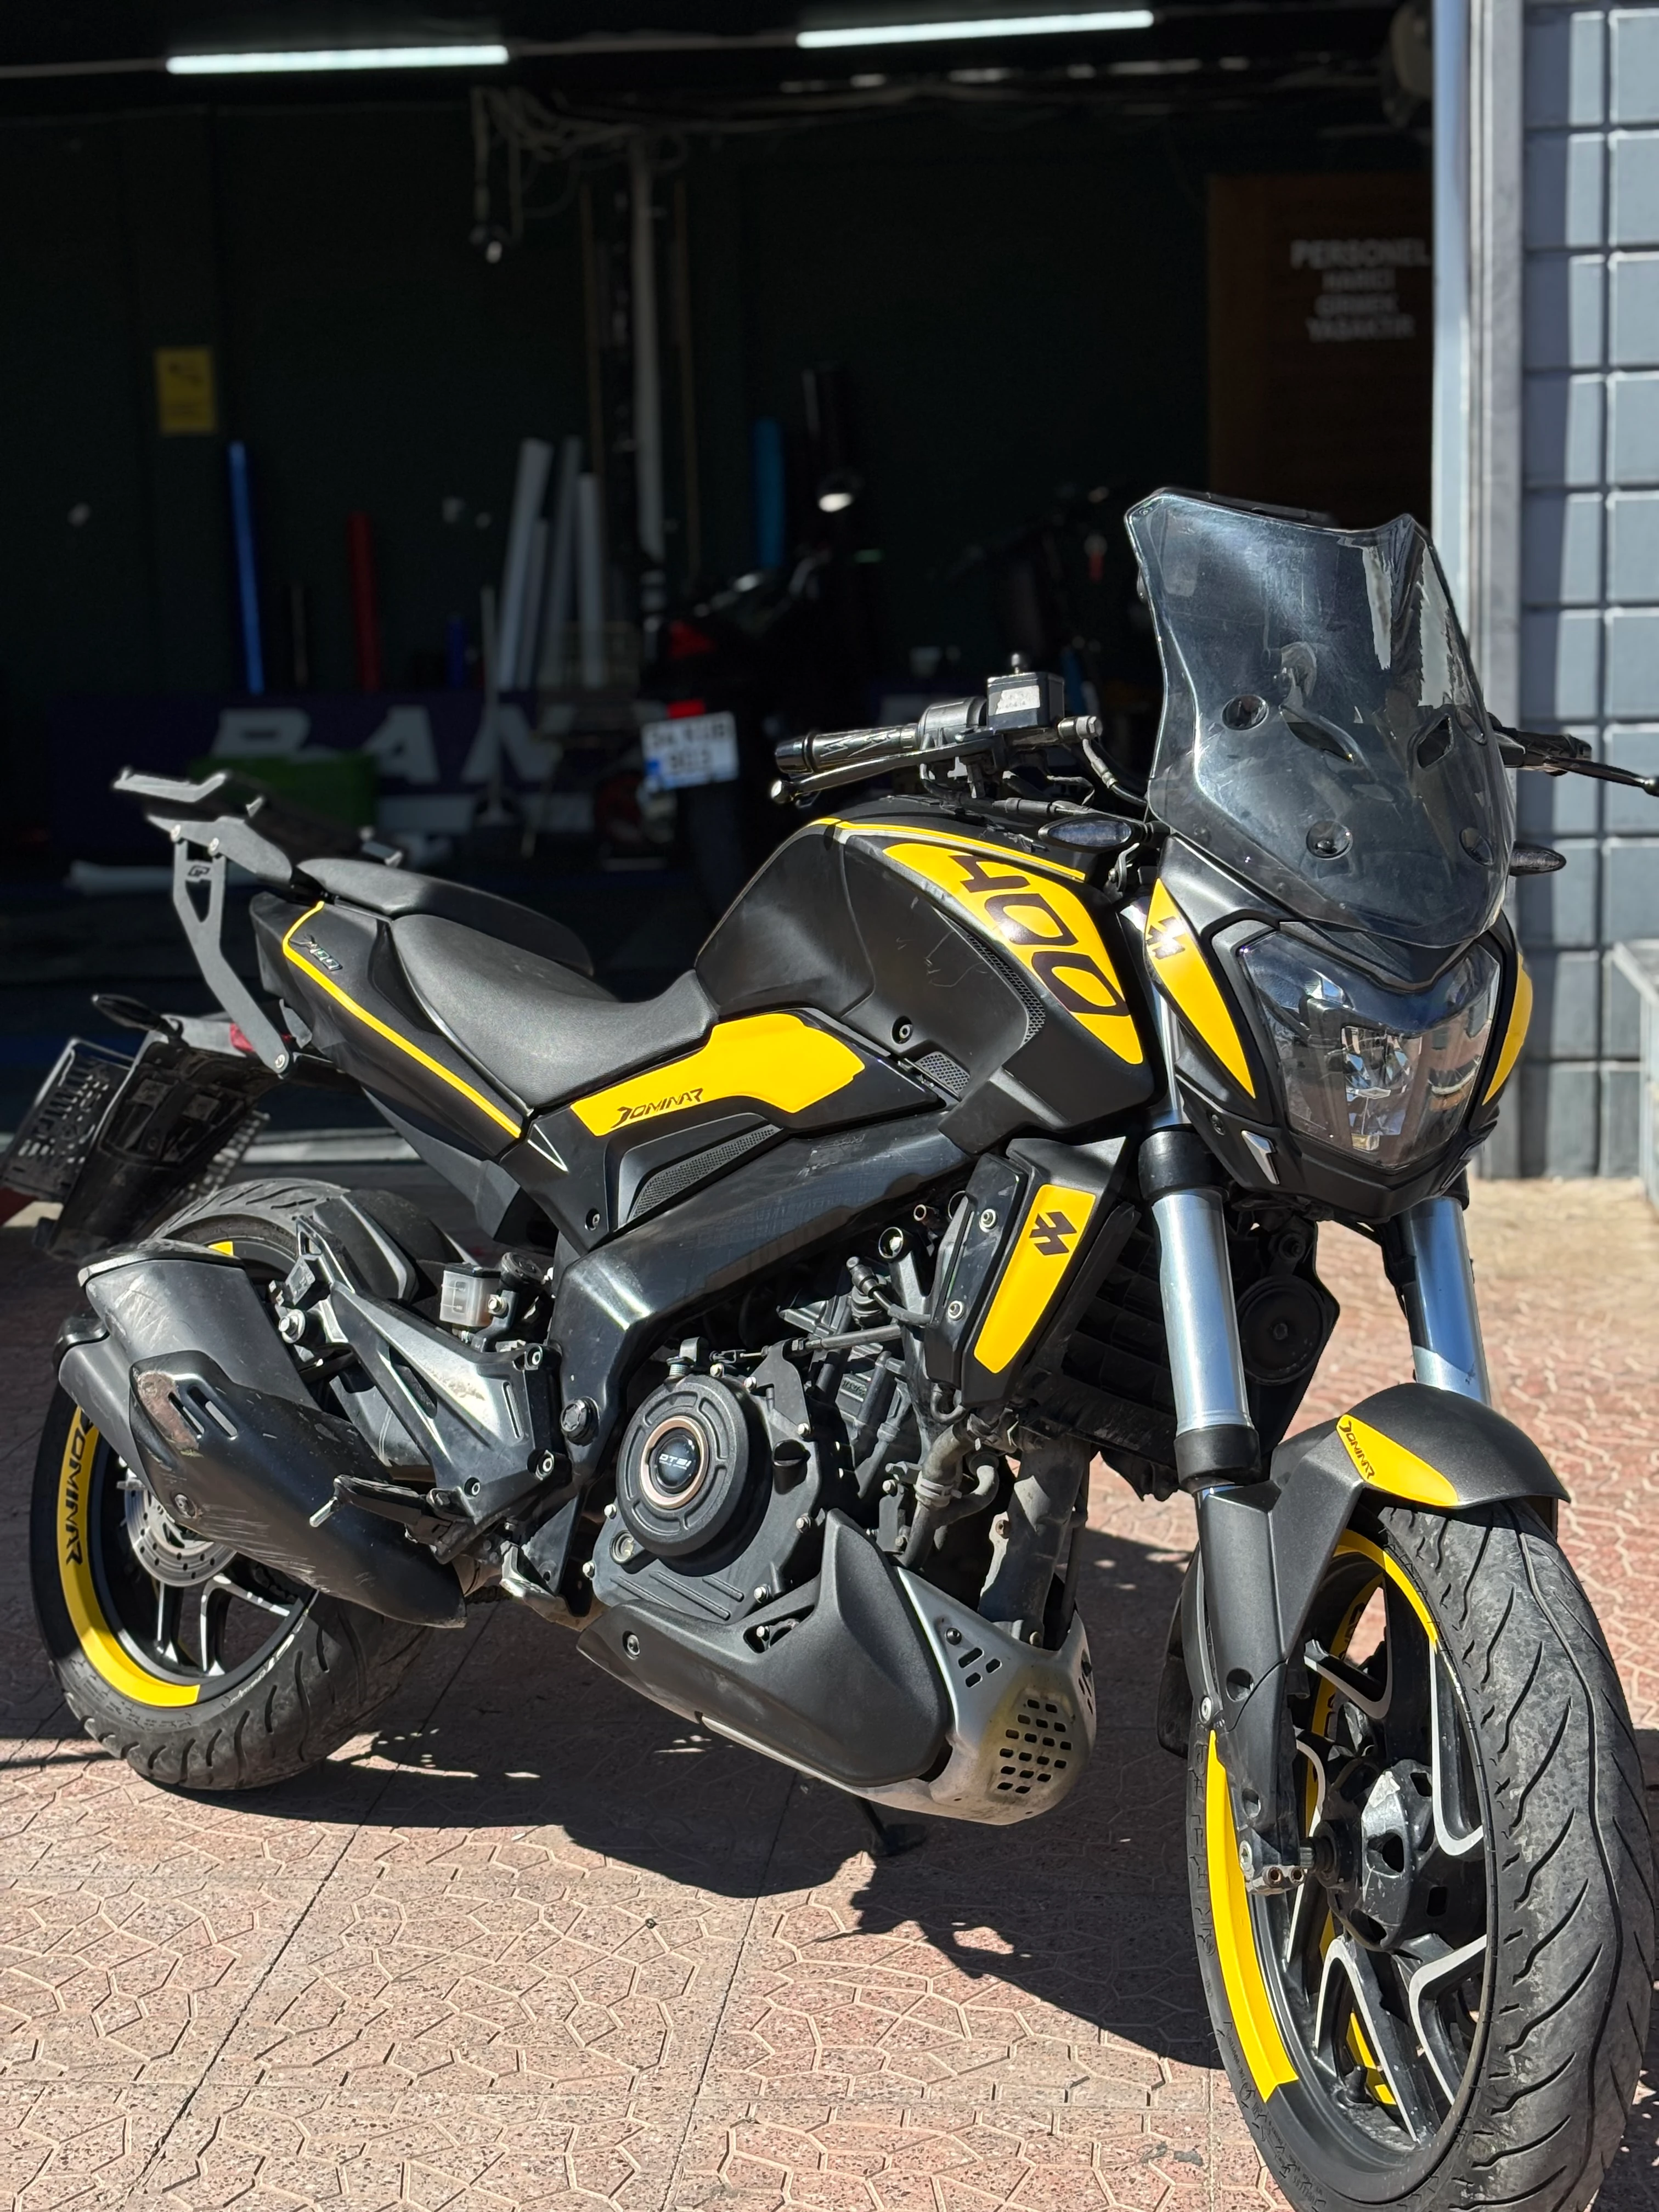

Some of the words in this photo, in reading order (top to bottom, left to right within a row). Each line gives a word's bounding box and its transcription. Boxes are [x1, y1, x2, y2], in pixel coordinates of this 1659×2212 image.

[1290, 239, 1431, 269] PERSONEL
[948, 855, 1130, 1016] 400
[610, 1087, 703, 1128] DOMINAR
[1339, 1420, 1375, 1480] DOMINAR
